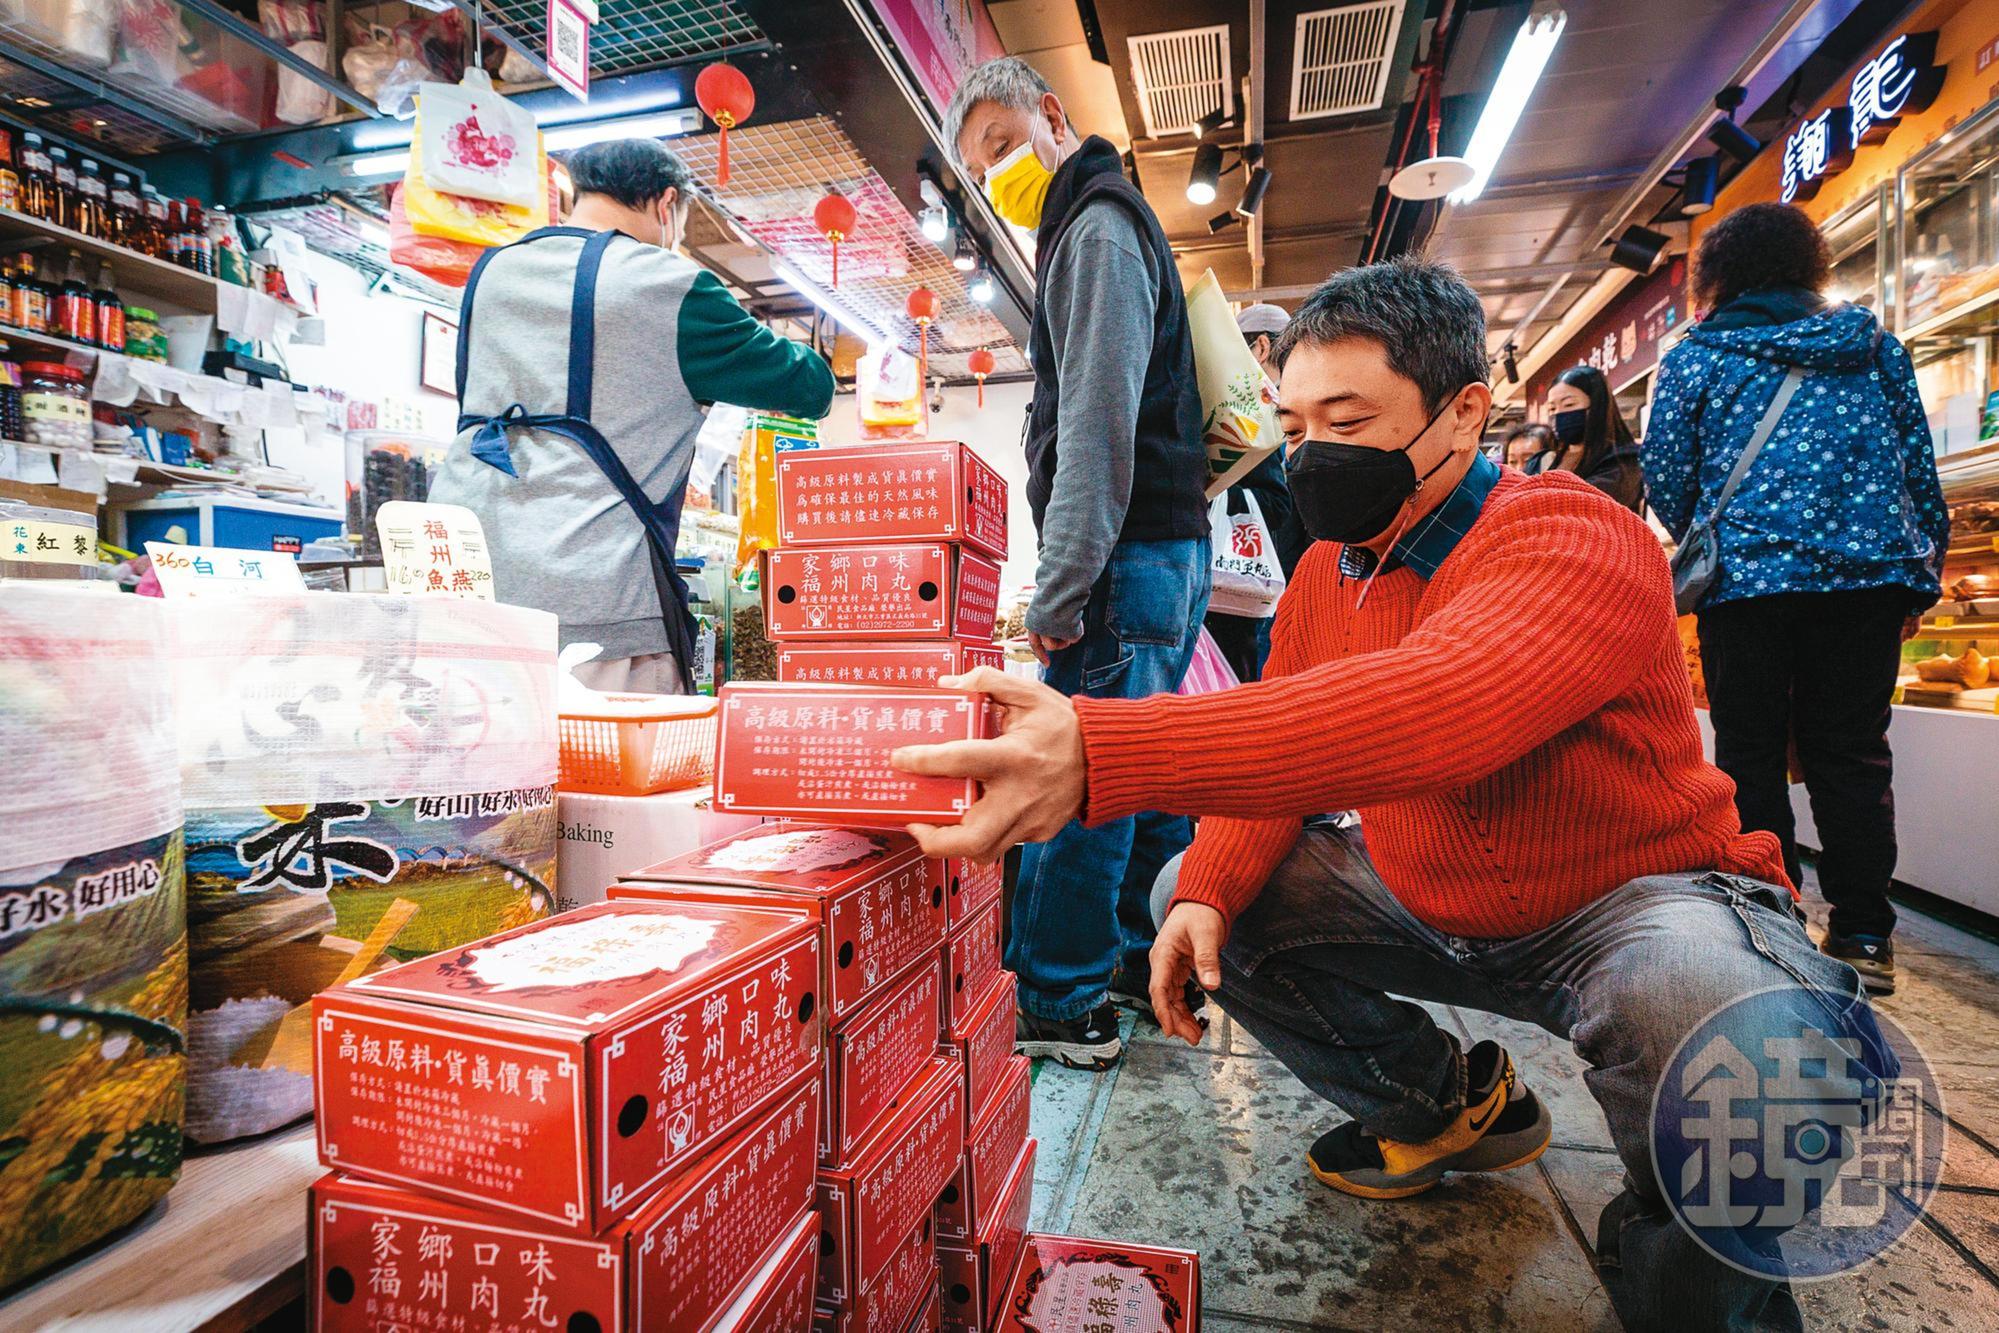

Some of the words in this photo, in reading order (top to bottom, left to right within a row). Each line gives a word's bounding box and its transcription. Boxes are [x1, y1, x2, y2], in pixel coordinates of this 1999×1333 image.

[13, 526, 28, 554] 花東
[192, 556, 262, 579] 白河
[802, 552, 911, 575] 家鄉口味
[800, 572, 911, 592] 福州肉丸
[79, 862, 160, 911] 好用心
[858, 860, 929, 920] 家鄉口味
[858, 885, 930, 946] 福州肉丸
[659, 957, 793, 1057] 家鄉口味
[657, 992, 793, 1095] 福州肉丸
[369, 1215, 558, 1287] 家鄉口味
[368, 1257, 559, 1329] 福州肉丸
